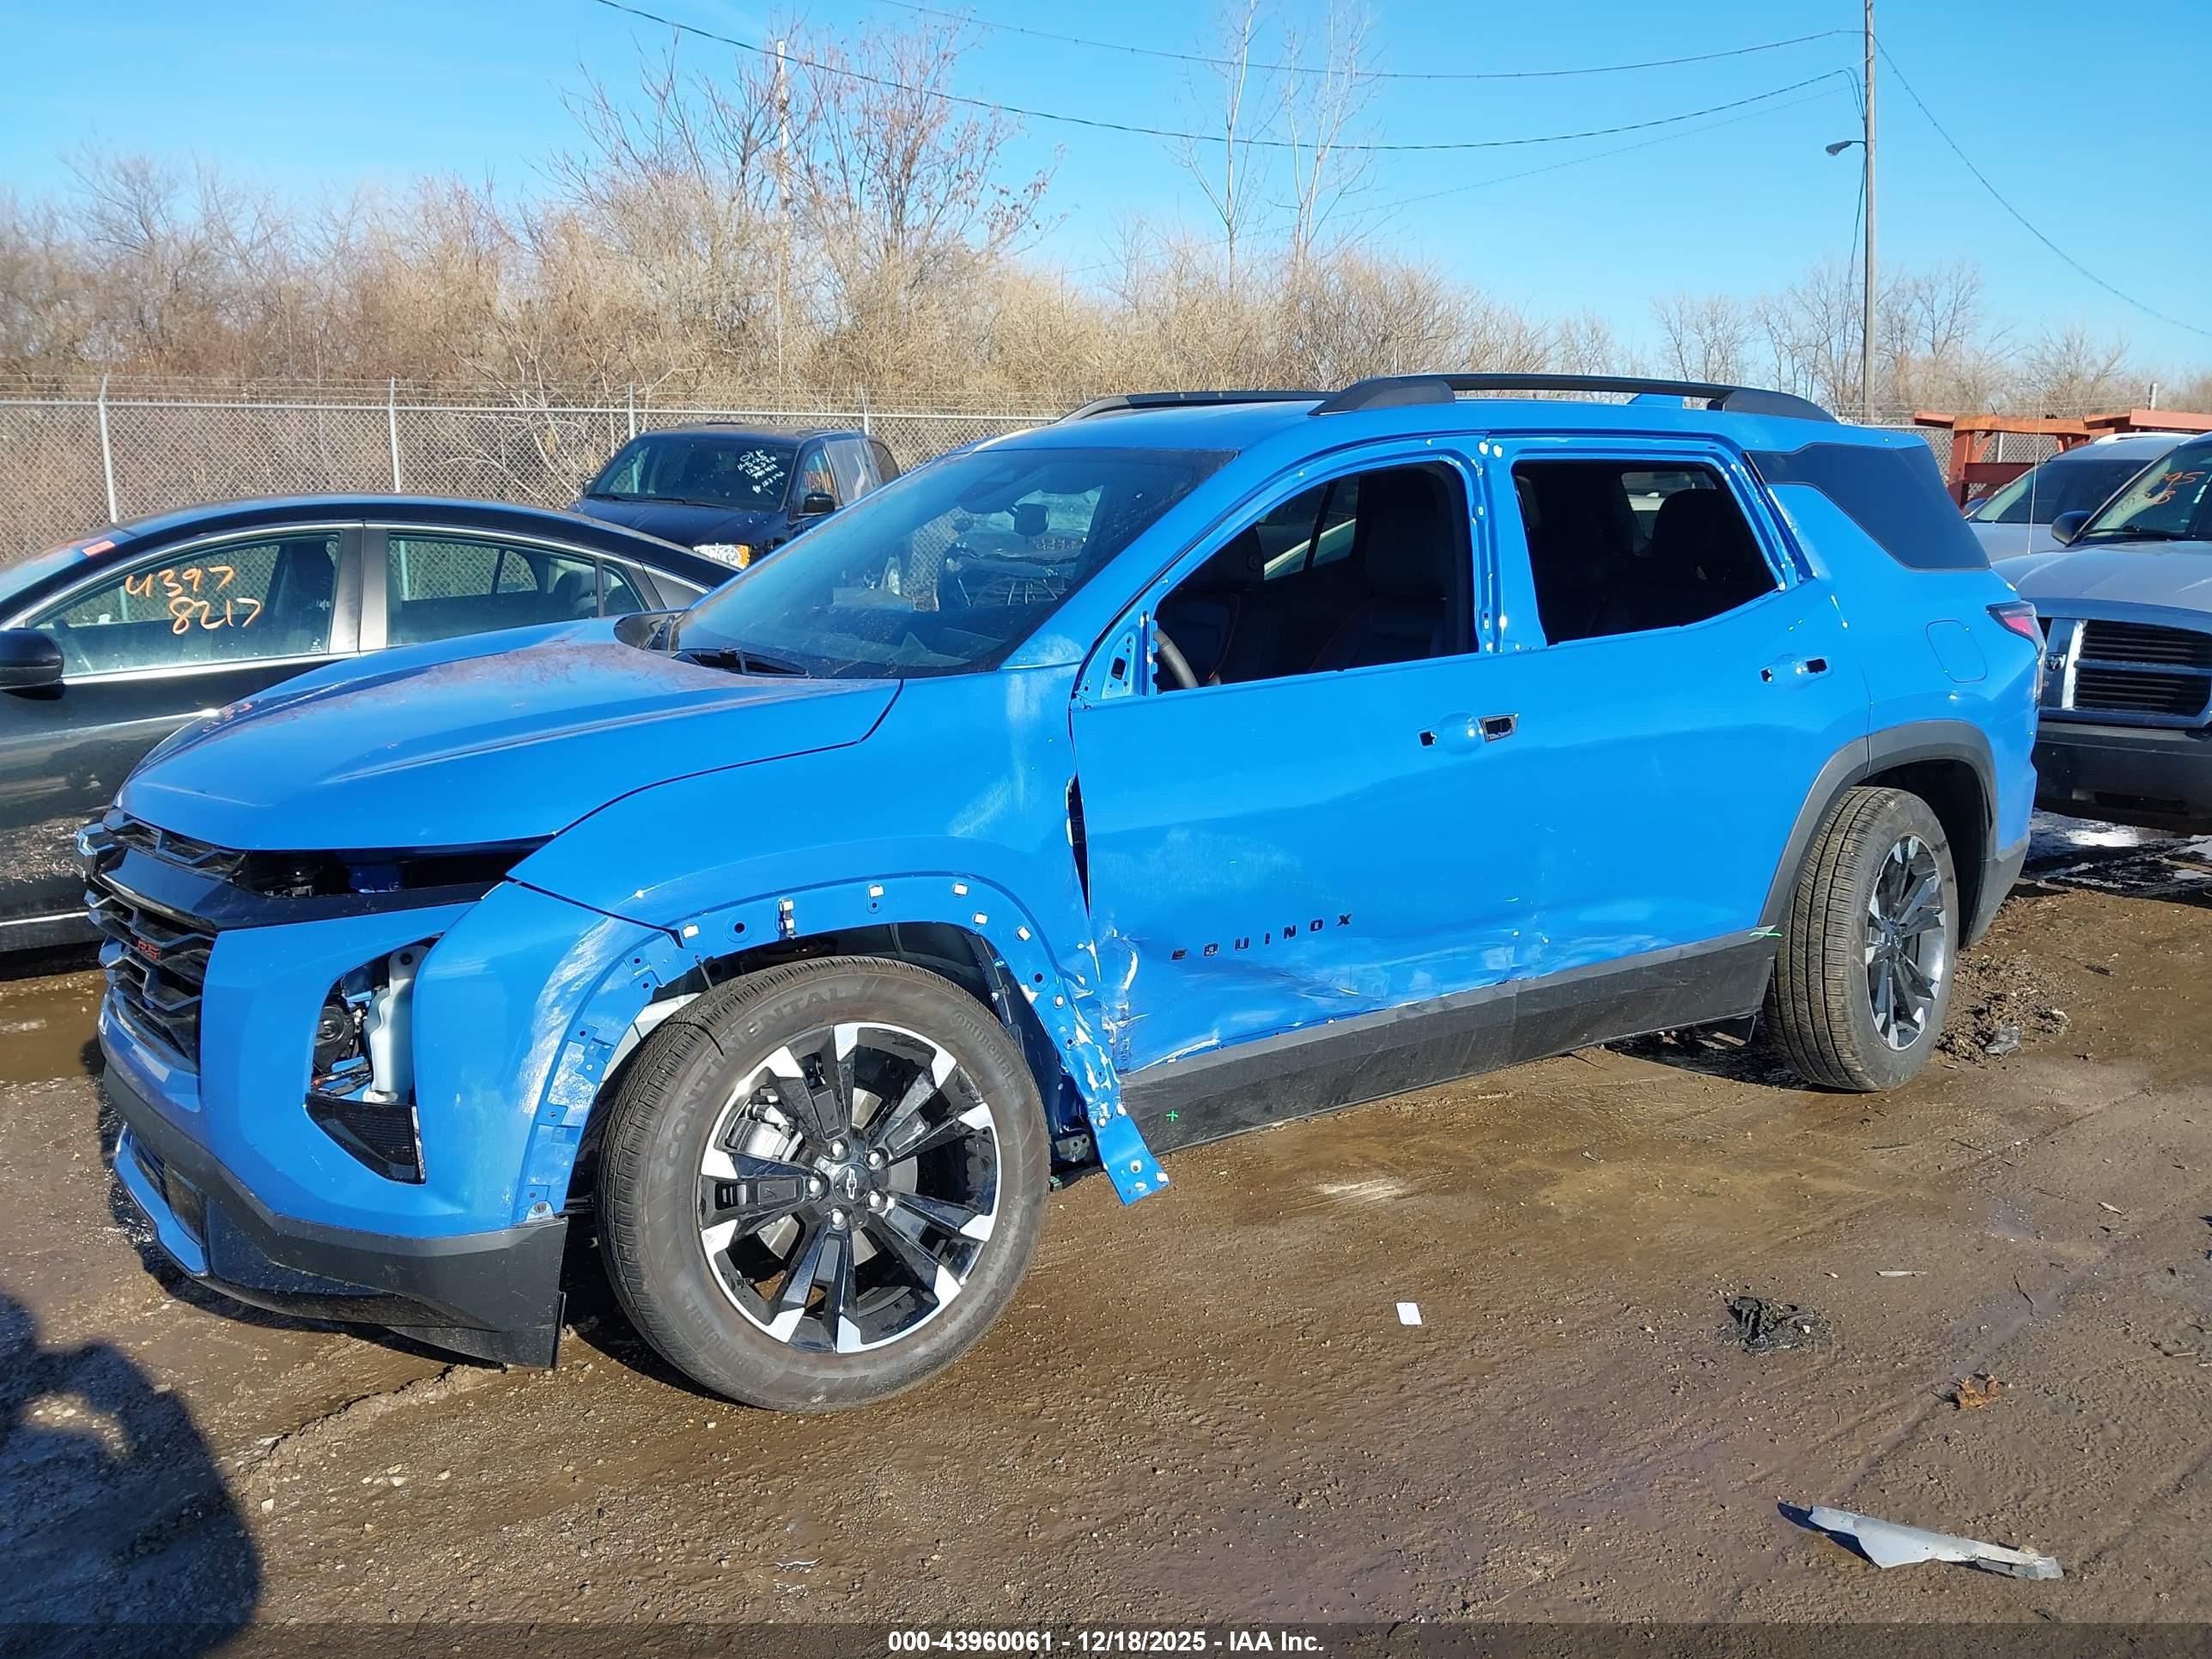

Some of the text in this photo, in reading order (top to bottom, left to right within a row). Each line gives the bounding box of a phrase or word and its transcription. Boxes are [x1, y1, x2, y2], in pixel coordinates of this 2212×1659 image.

[125, 565, 234, 598] 4397
[169, 597, 261, 635] 8217
[137, 939, 160, 960] RS
[1171, 914, 1352, 961] EQUINOX
[952, 1009, 1015, 1078] Continental
[666, 988, 852, 1166] CONTINENTAL
